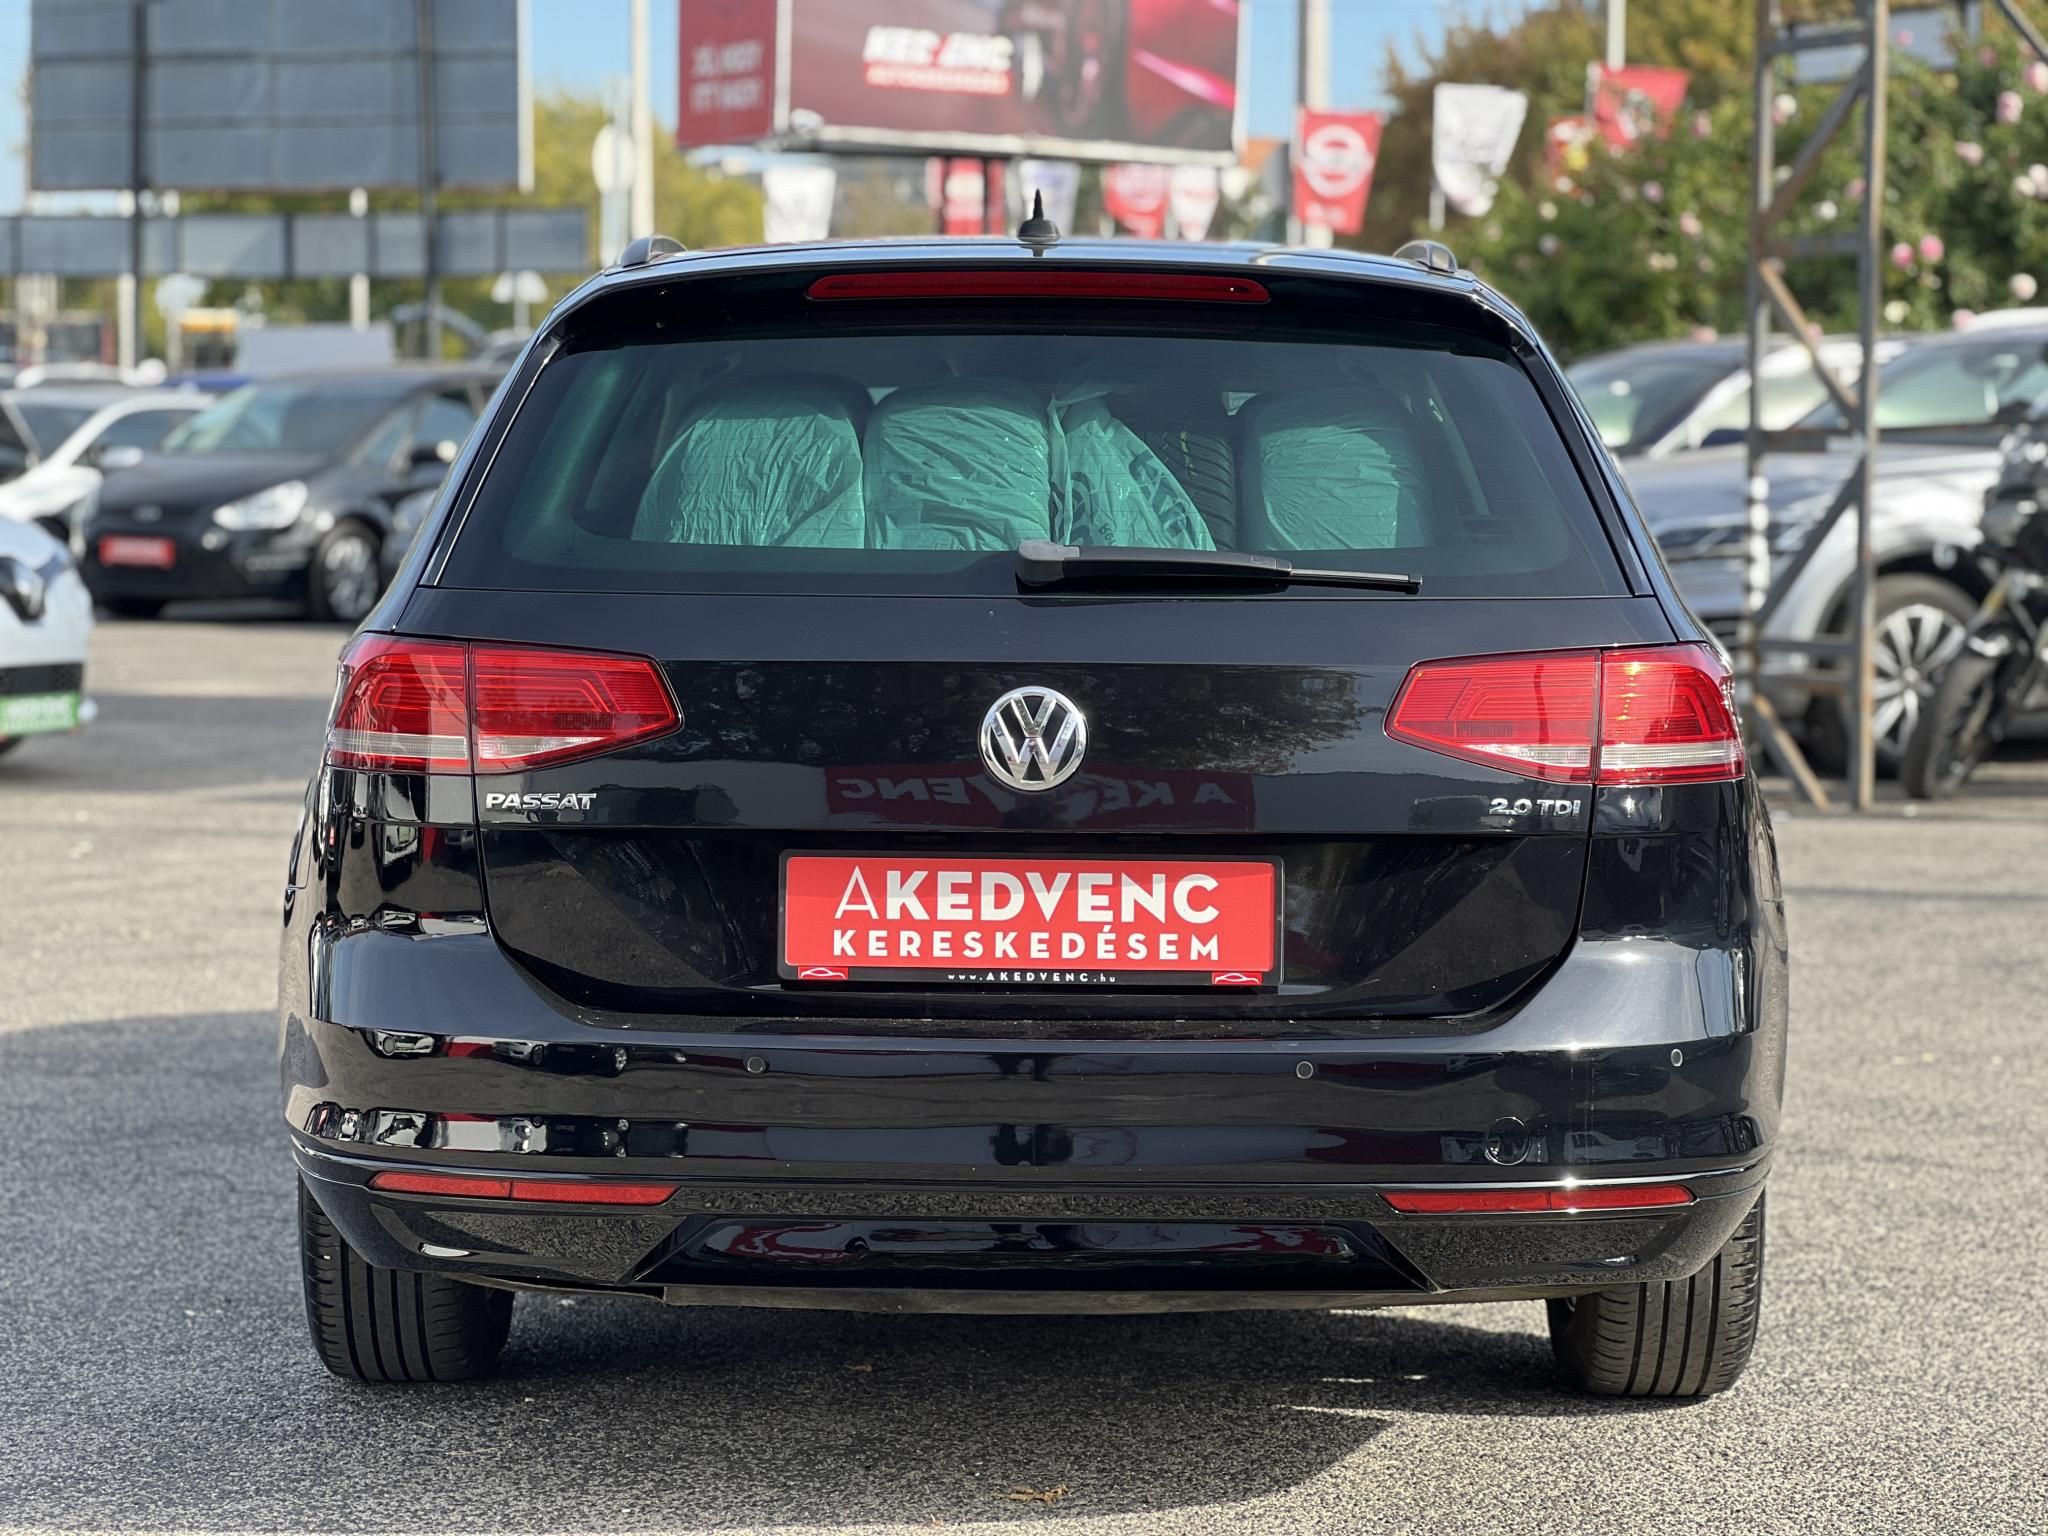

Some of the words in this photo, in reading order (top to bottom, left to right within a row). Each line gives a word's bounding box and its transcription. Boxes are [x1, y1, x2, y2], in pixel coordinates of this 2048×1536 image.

[485, 792, 597, 811] PASSAT
[1488, 798, 1533, 815] 2.0
[1537, 799, 1582, 817] TDI
[833, 925, 1219, 960] KERESKEDÉSEM
[947, 971, 1116, 983] www.AKEDVENC.hu
